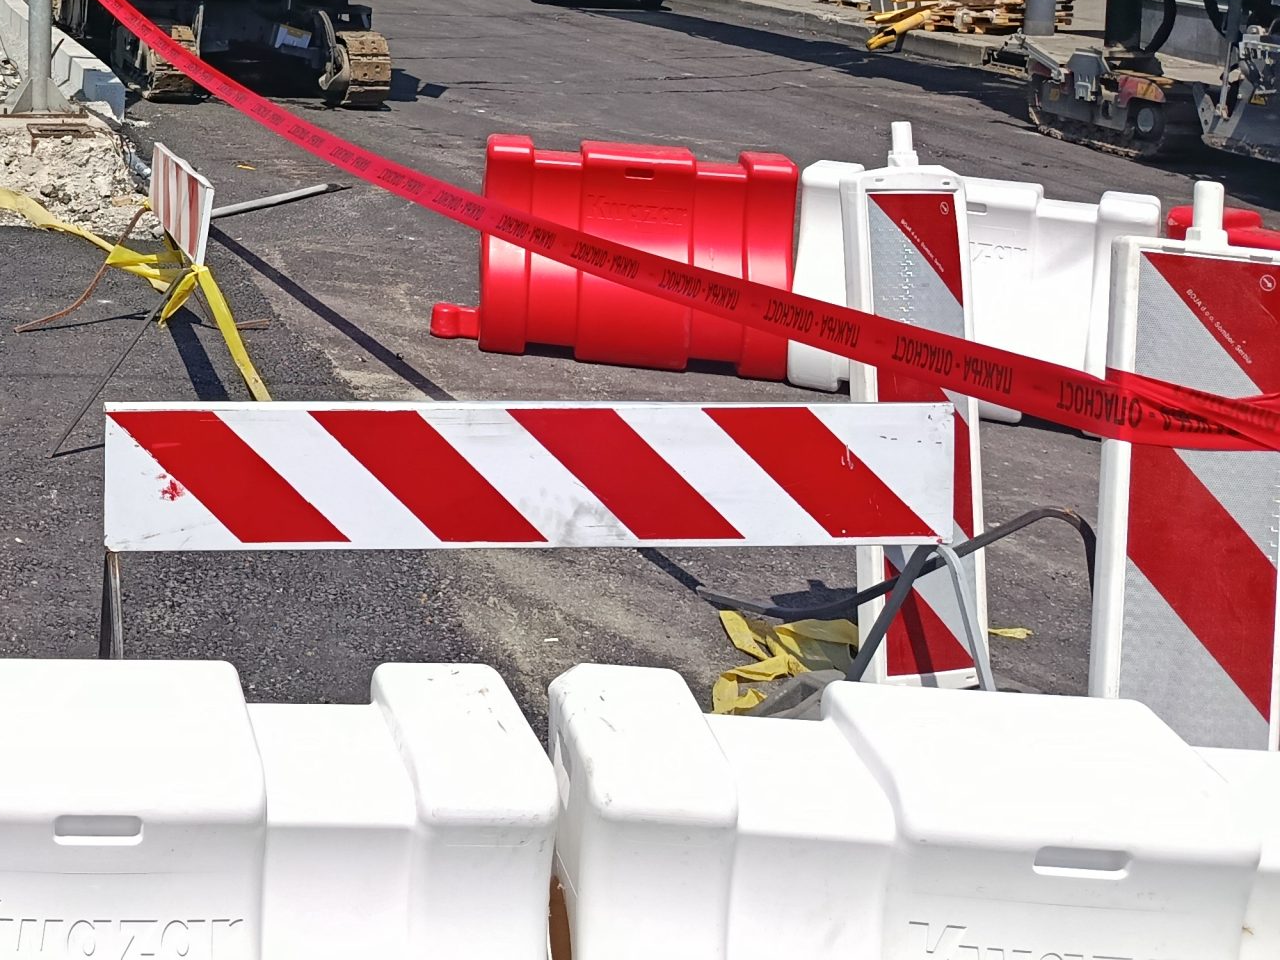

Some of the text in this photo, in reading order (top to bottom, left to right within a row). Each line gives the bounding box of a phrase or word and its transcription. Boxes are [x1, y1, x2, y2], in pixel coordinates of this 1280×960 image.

[657, 268, 740, 311] ПАЖЊА ОПАСНОСТ
[1186, 288, 1202, 307] BOJA
[762, 298, 861, 349] ПАЖЊА ОПАСНОСТ
[891, 335, 1013, 395] ПАЖЊА ОПАСНОСТ
[1056, 380, 1144, 428] ОПАСНОСТ
